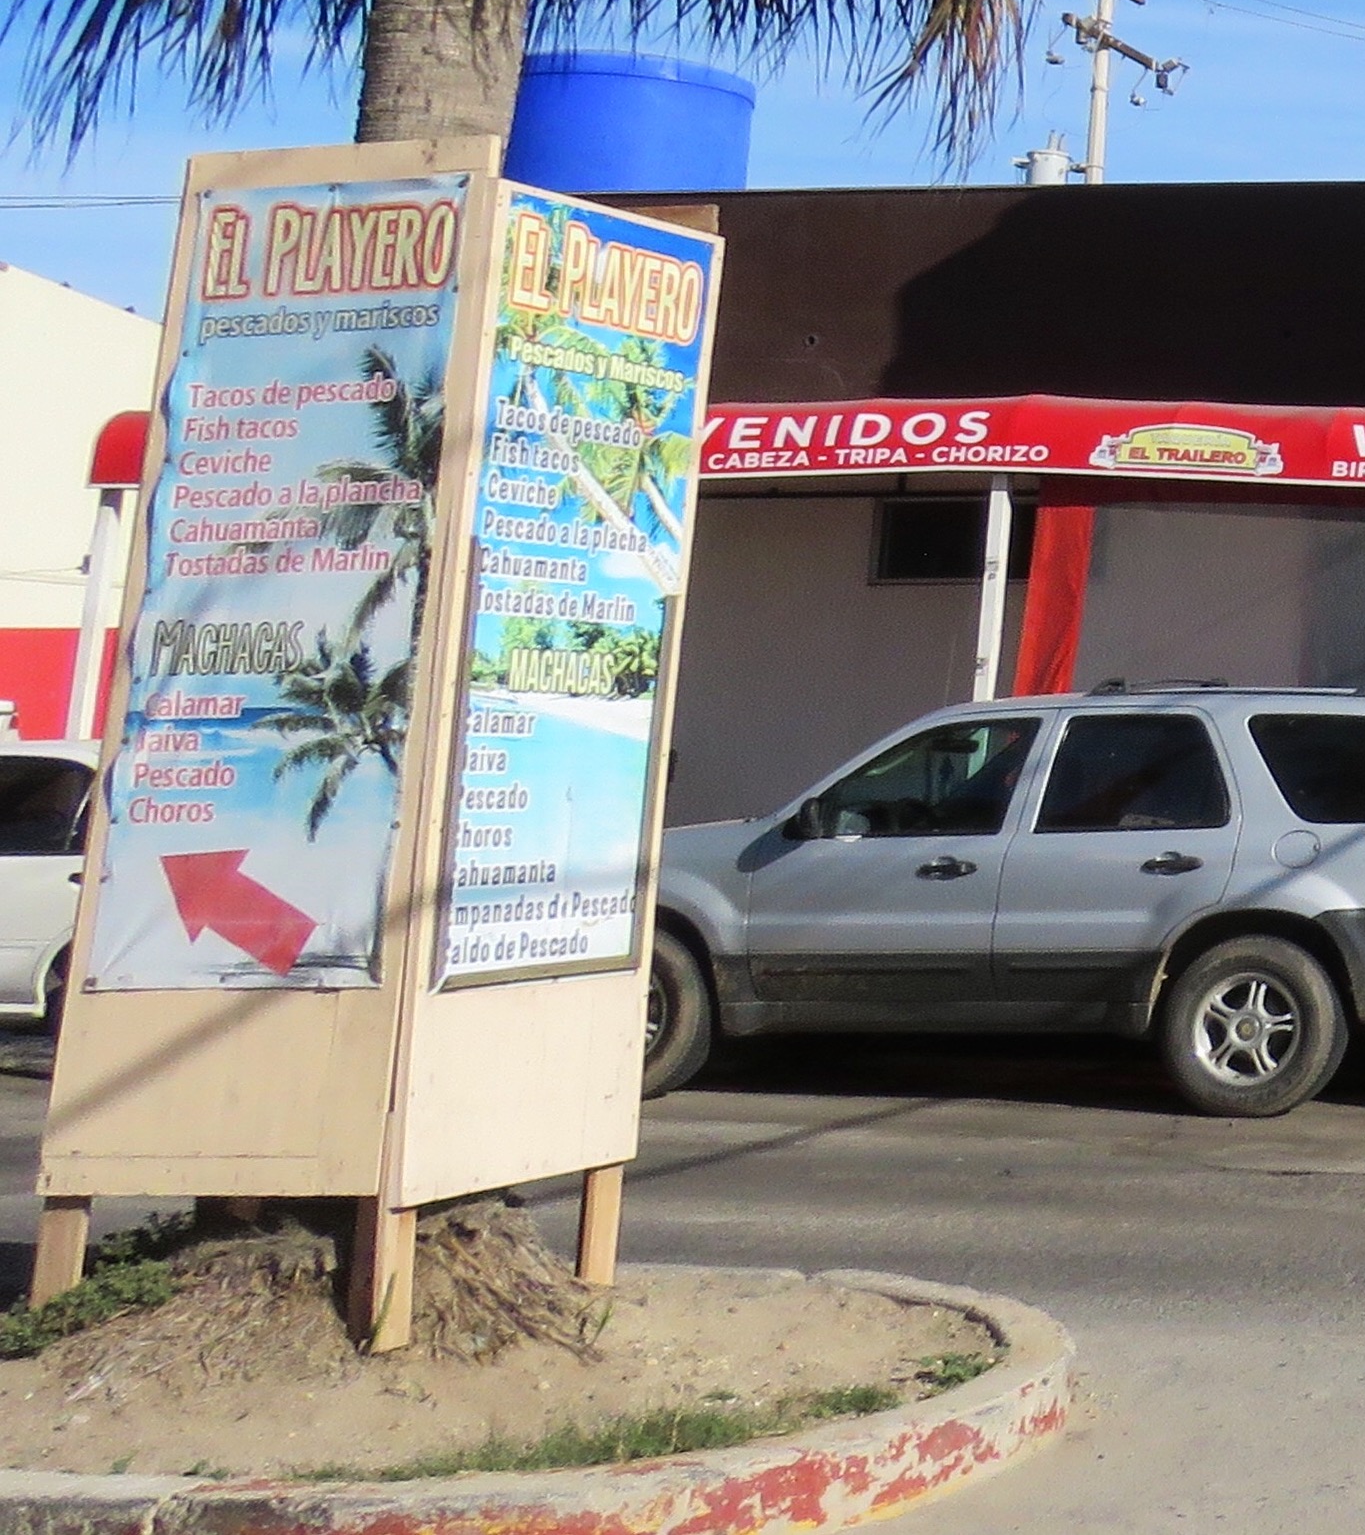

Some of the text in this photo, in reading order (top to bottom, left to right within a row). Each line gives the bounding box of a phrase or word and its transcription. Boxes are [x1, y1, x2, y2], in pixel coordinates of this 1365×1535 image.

[202, 201, 459, 300] EL PLAYERO
[509, 213, 704, 346] EL PLAYERO
[199, 300, 440, 345] pescados y mariscos
[510, 336, 685, 392] Pescados y Mariscos
[189, 373, 396, 410] Tacos de pescado
[183, 416, 298, 442] Fish tacos
[499, 399, 641, 446] Tacos de pescado
[179, 449, 272, 476] Ceviche
[491, 435, 580, 474] Fish tacos
[707, 447, 811, 470] CABEZA
[834, 447, 909, 466] TRIPA
[931, 444, 1050, 464] CHORIZO
[1128, 446, 1248, 465] EL TRAILERO
[173, 475, 422, 510] Pescado a la plancha
[488, 473, 557, 506] Ceviche
[170, 516, 319, 543] Cahuamanta
[484, 509, 647, 554] Pescado a la placha
[165, 546, 268, 577] Tostadas
[275, 547, 305, 573] de
[480, 547, 587, 582] Cahuamanta
[558, 592, 578, 617] de
[150, 619, 304, 677] MACHACAS
[508, 647, 617, 696] MACHACAS
[145, 690, 245, 717] Calamar
[134, 761, 235, 788] Pescado
[129, 797, 214, 824] Choros
[458, 820, 513, 848] horos
[454, 859, 556, 887] ahuamanta
[450, 894, 544, 932] mpanadas
[450, 928, 588, 965] aldo de Pescado
